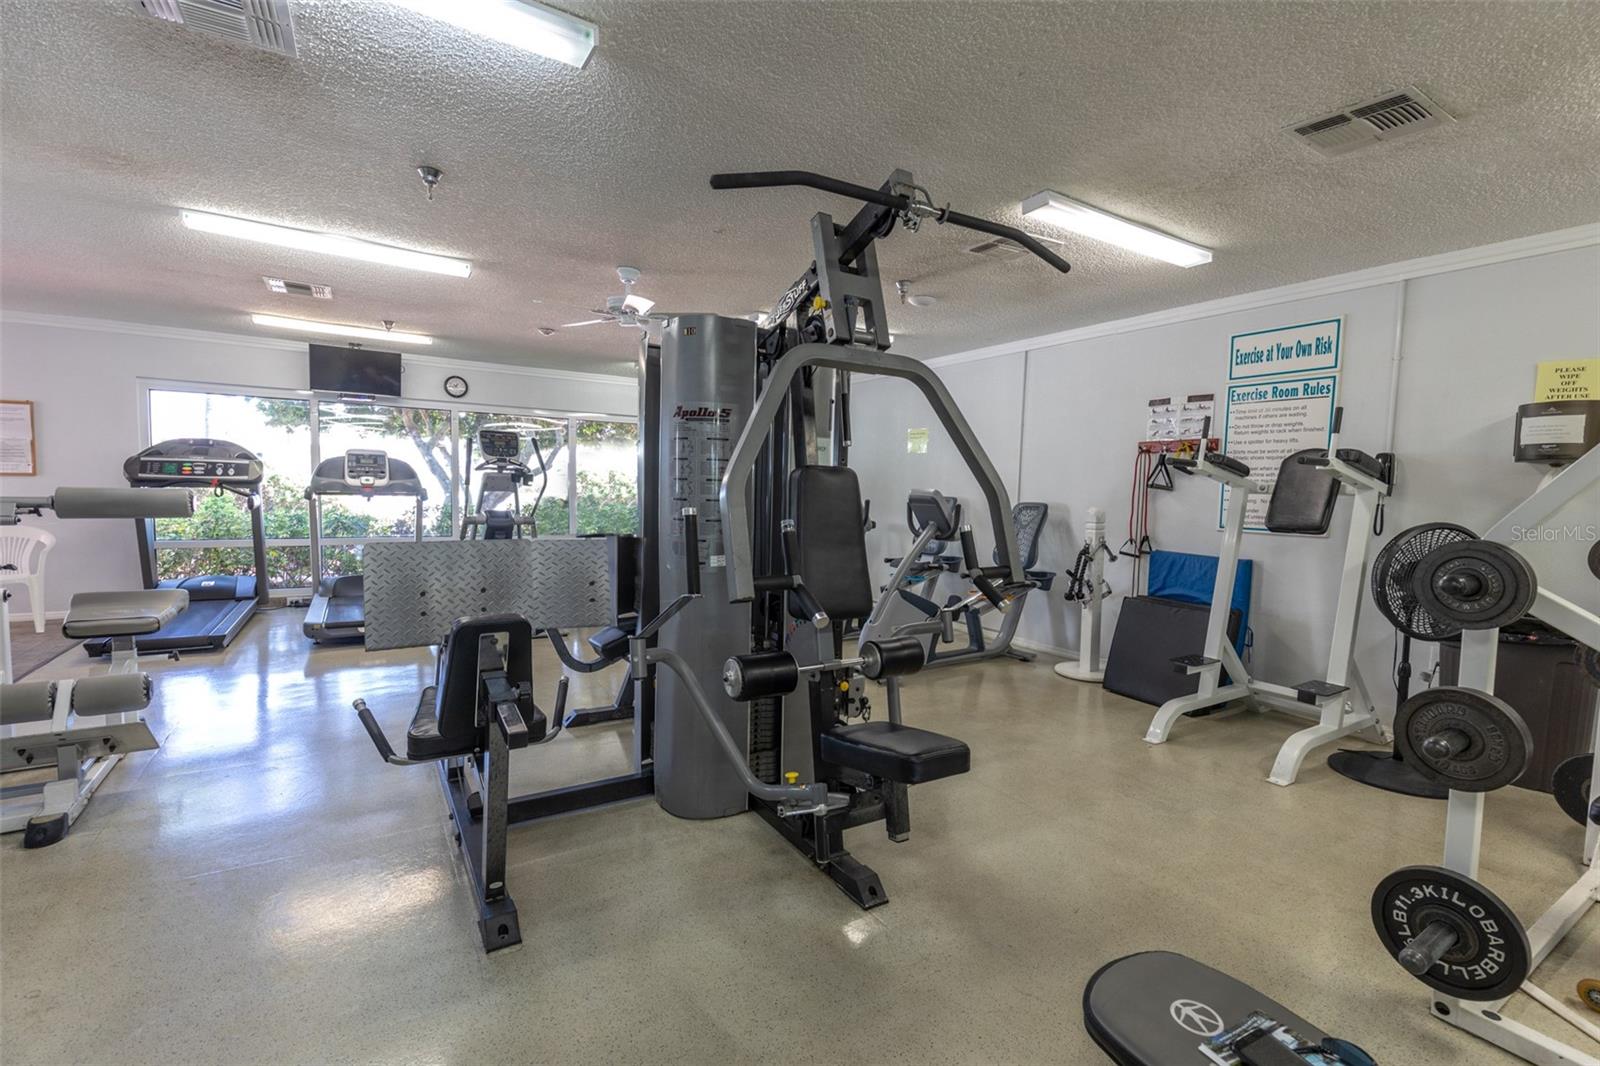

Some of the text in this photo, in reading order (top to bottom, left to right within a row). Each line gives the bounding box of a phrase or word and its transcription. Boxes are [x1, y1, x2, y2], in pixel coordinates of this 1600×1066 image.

[1235, 335, 1333, 366] Exercise at Your Own Risk
[1231, 382, 1331, 402] Exercise Room Rules
